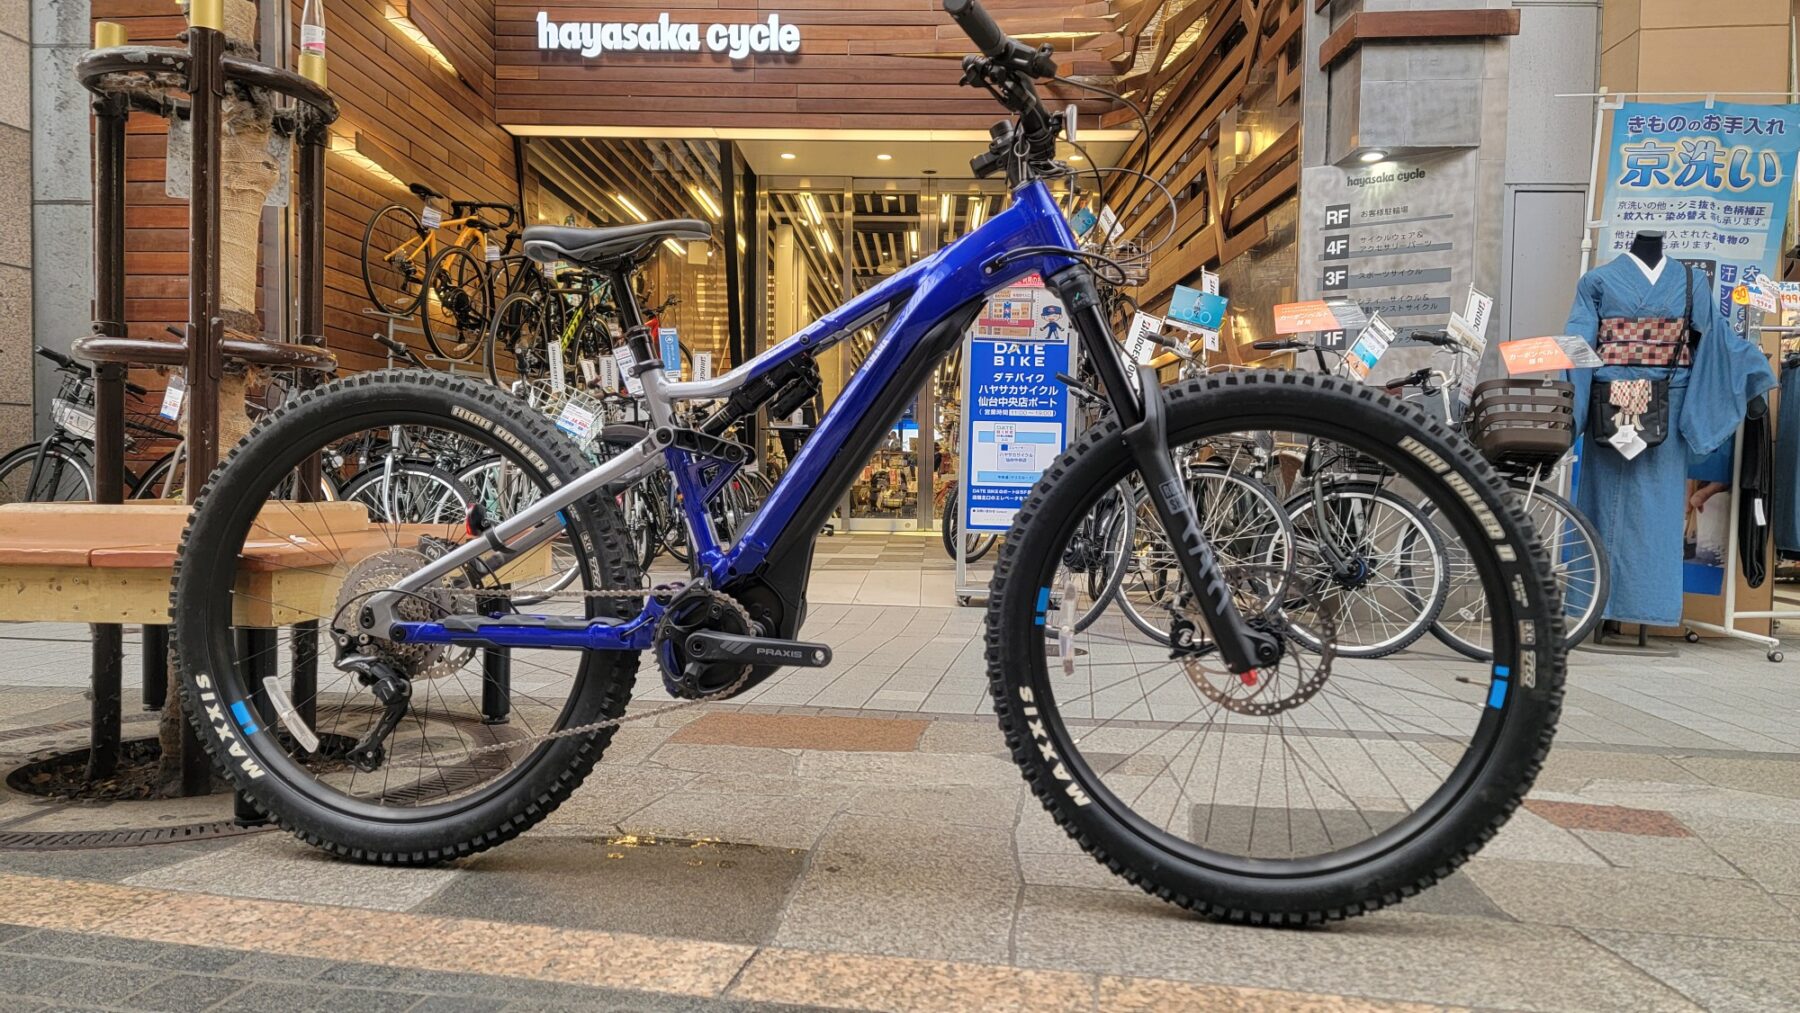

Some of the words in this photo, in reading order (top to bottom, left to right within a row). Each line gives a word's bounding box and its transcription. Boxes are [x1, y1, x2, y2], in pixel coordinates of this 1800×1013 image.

[536, 12, 701, 58] hayasaka
[706, 13, 800, 59] cycle
[1627, 114, 1786, 135] きもののお手入れ
[1618, 139, 1778, 190] 京洗い
[1346, 171, 1395, 188] hayasaka
[1397, 168, 1426, 183] cycle
[1326, 209, 1349, 226] RF
[1326, 240, 1348, 256] 4F
[1325, 270, 1346, 286] 3F
[1779, 281, 1800, 292] デニム
[1780, 293, 1800, 304] ¥99
[1361, 303, 1438, 315] 動アシストサイクル
[1324, 331, 1344, 346] 1F
[993, 356, 1046, 367] BIKE
[993, 372, 1045, 383] ダテバイク
[978, 384, 1059, 396] ハヤサカサイクル
[978, 396, 1058, 408] 仙台中央店ポート
[451, 405, 494, 432] HIGH
[493, 424, 549, 474] ROLLER
[1398, 435, 1451, 474] HIGH
[1443, 470, 1506, 541] ROLLER
[756, 647, 803, 659] PRAXIS
[194, 673, 267, 780] MAXXIS
[1018, 685, 1092, 807] MAXXIS
